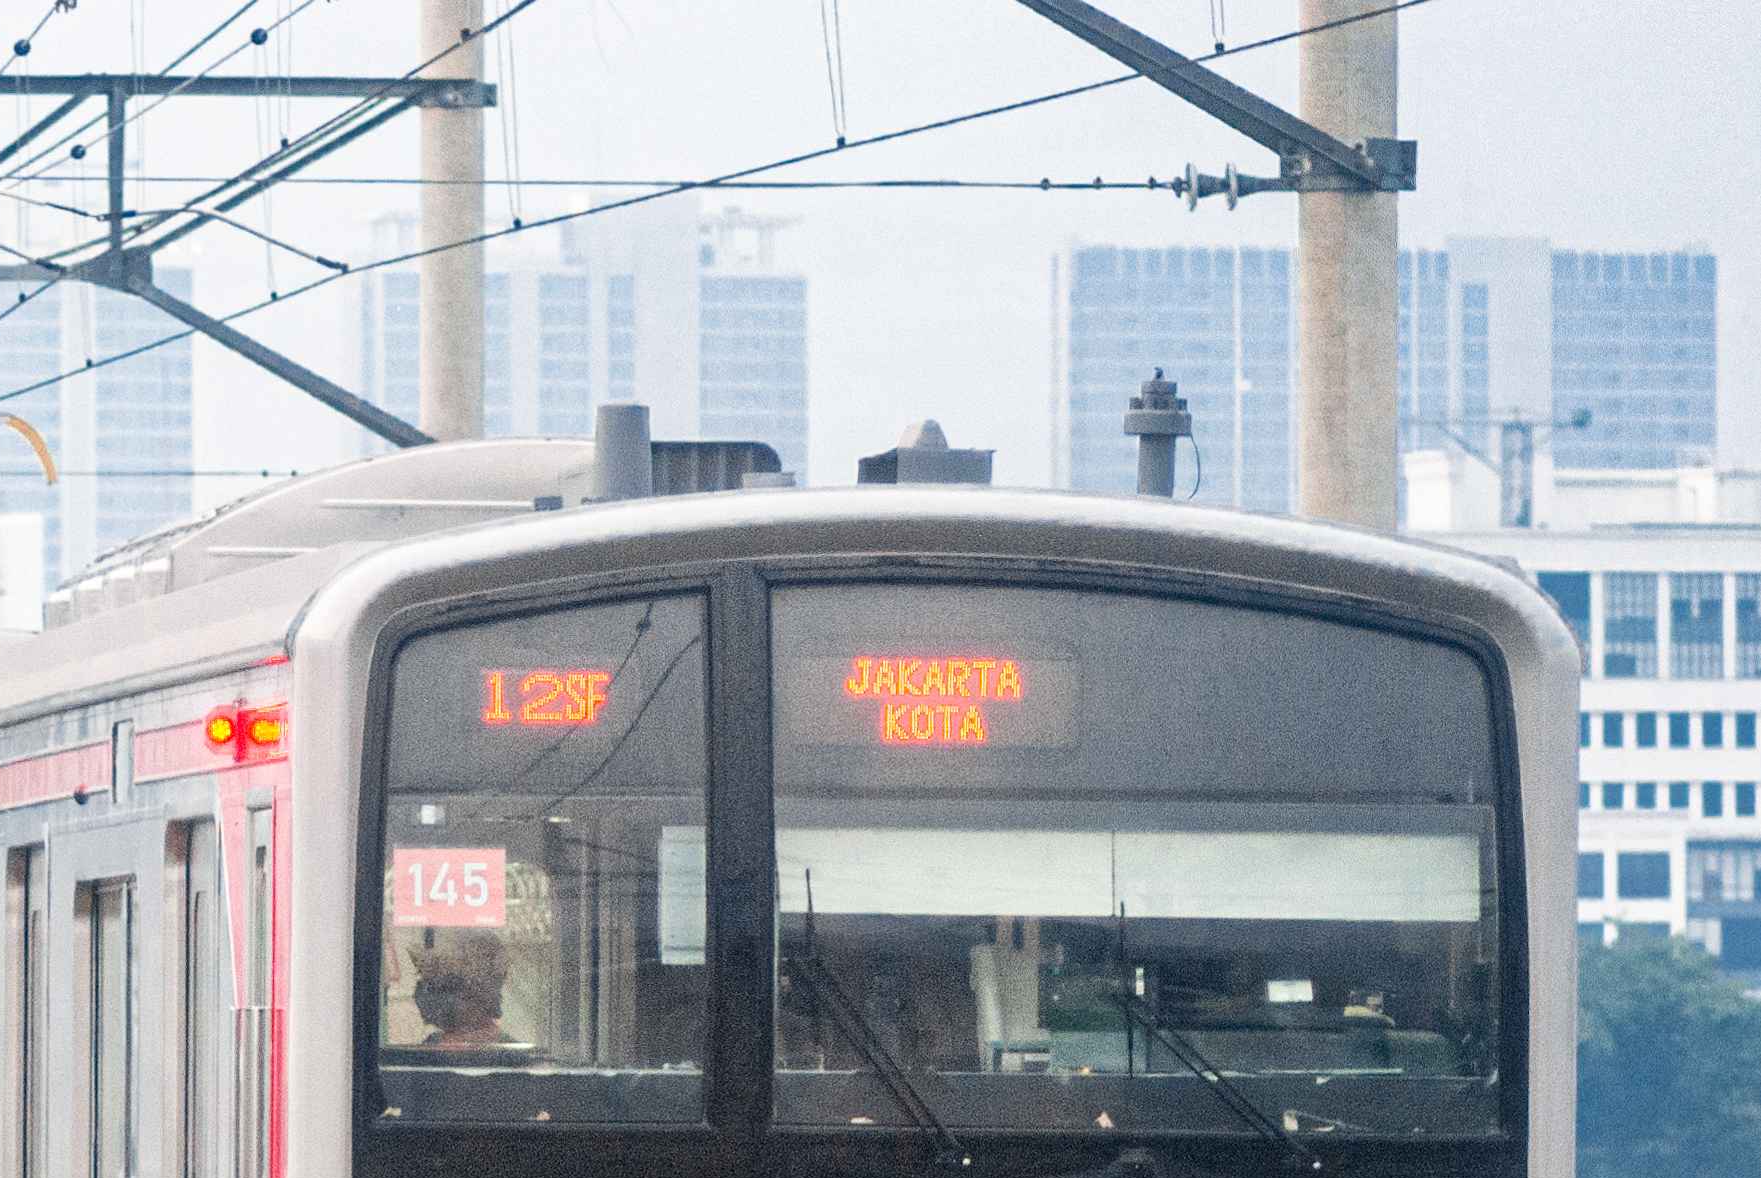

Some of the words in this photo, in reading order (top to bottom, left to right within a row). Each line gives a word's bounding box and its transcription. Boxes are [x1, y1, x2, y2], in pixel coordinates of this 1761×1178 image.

[485, 671, 609, 721] 12SF
[847, 659, 1021, 698] JAKARTA
[884, 703, 985, 741] KOTA
[408, 862, 489, 907] 145
